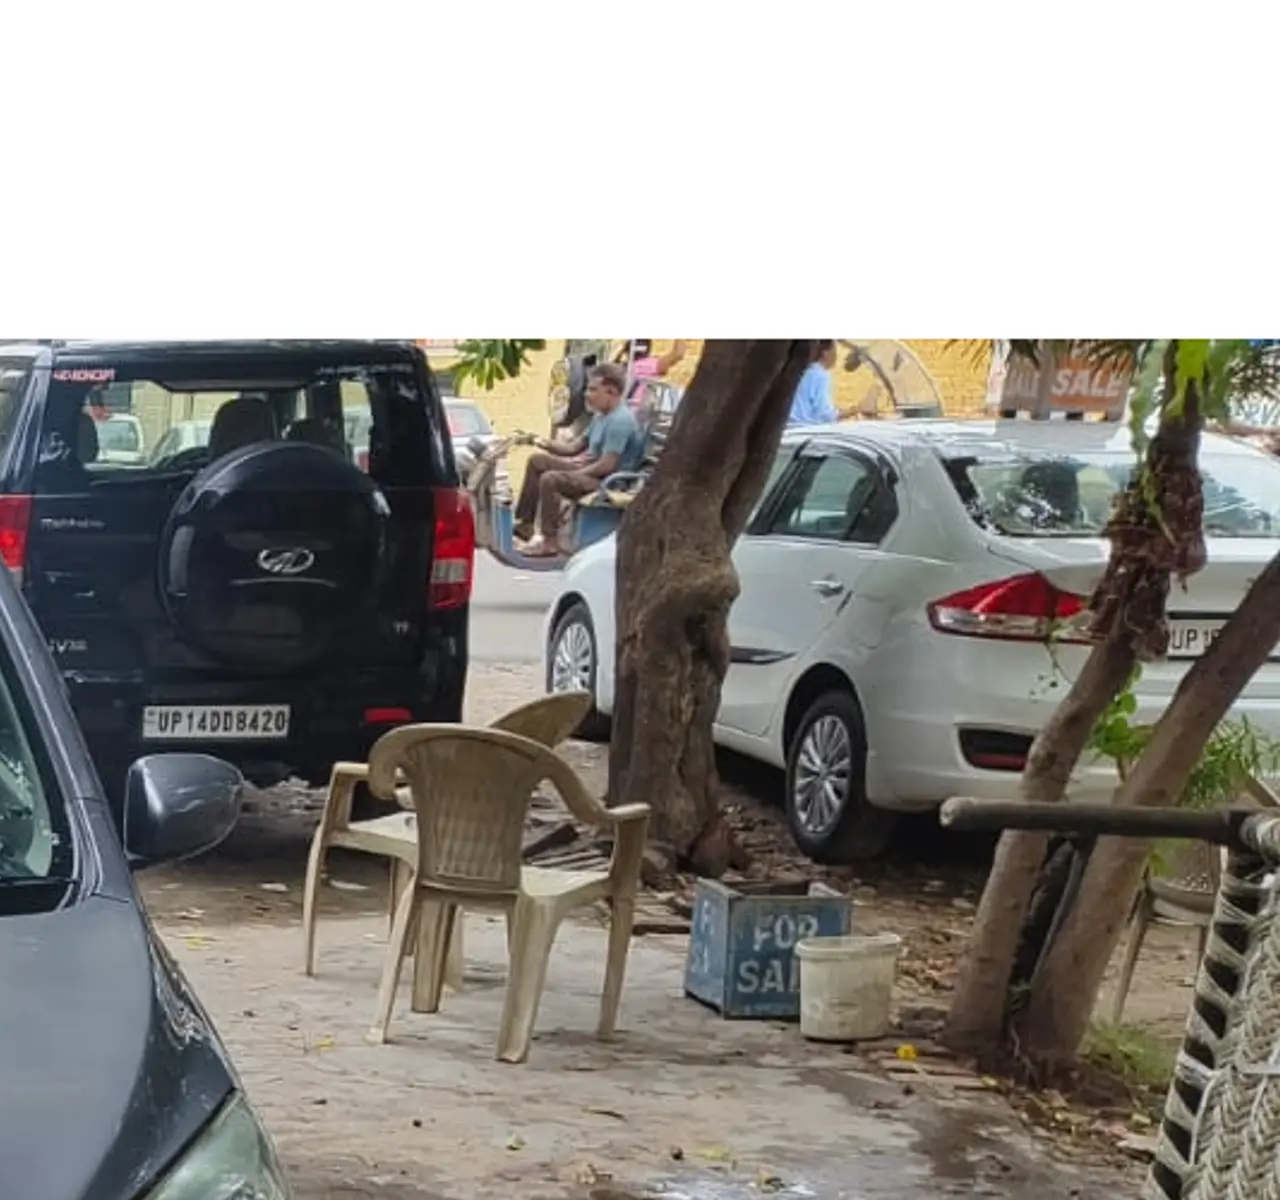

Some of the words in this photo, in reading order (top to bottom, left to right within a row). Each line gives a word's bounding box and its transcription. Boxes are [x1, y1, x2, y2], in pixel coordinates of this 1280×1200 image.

[1051, 368, 1123, 397] SALE
[158, 710, 286, 733] UP14DD8420
[753, 914, 819, 951] FOR
[737, 960, 801, 994] SAL
